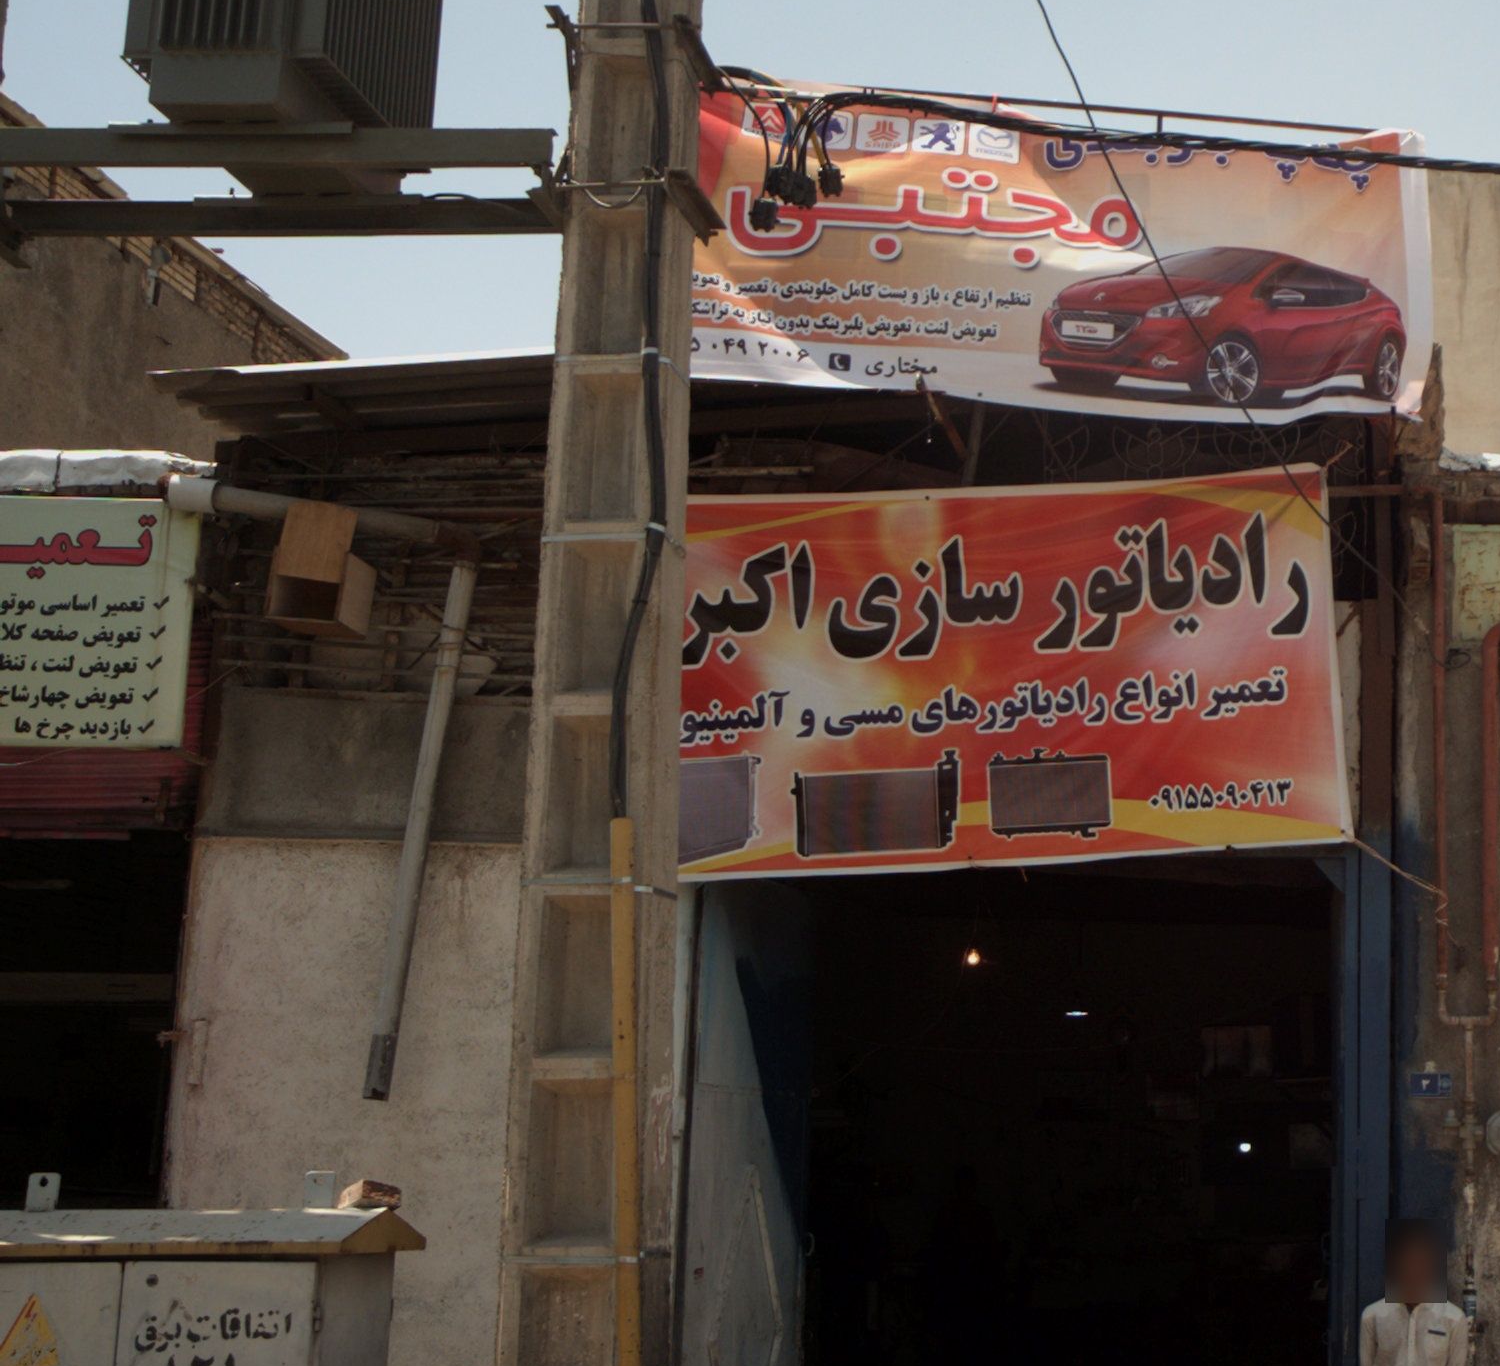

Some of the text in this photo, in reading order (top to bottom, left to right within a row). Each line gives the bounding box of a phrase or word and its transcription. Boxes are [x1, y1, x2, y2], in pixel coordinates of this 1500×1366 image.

[729, 169, 1141, 266] مجتبی
[692, 272, 720, 286] تعوی
[736, 280, 768, 296] تعمیر
[780, 281, 837, 299] جلوبندی
[841, 283, 875, 301] کامل
[878, 287, 907, 303] بست
[911, 293, 919, 304] و
[922, 287, 940, 305] باز
[952, 289, 993, 309] ارتفاع
[996, 290, 1031, 309] تنظیم
[691, 302, 729, 321] تراشک
[732, 308, 745, 319] به
[749, 313, 772, 325] نیاز
[775, 318, 810, 333] بدون
[813, 315, 863, 335] بلبرینگ
[867, 318, 912, 337] تعویض
[924, 320, 949, 335] لنت
[952, 323, 997, 341] تعویض
[865, 356, 938, 378] مختاری
[0, 514, 158, 580] تعمی
[1035, 511, 1311, 654] رادیاتور
[40, 594, 98, 616] اساسی
[100, 595, 146, 618] تعمیر
[828, 535, 1021, 660] سازی
[0, 622, 142, 649] تعویض صفحه کلا
[42, 654, 76, 673] لنت
[78, 656, 139, 679] تعویض
[75, 687, 135, 710] تعویض
[1114, 671, 1195, 723] انواع
[1202, 669, 1287, 722] تعمیر
[680, 690, 789, 744] آلمینیو
[798, 707, 815, 738] و
[823, 700, 904, 736] مسی
[14, 716, 132, 741] بازدید چرخ ها
[1150, 779, 1293, 811] ۰۹۱۵۵۰۹۰۴۱۳
[134, 1307, 293, 1353] اتفاقات برق
